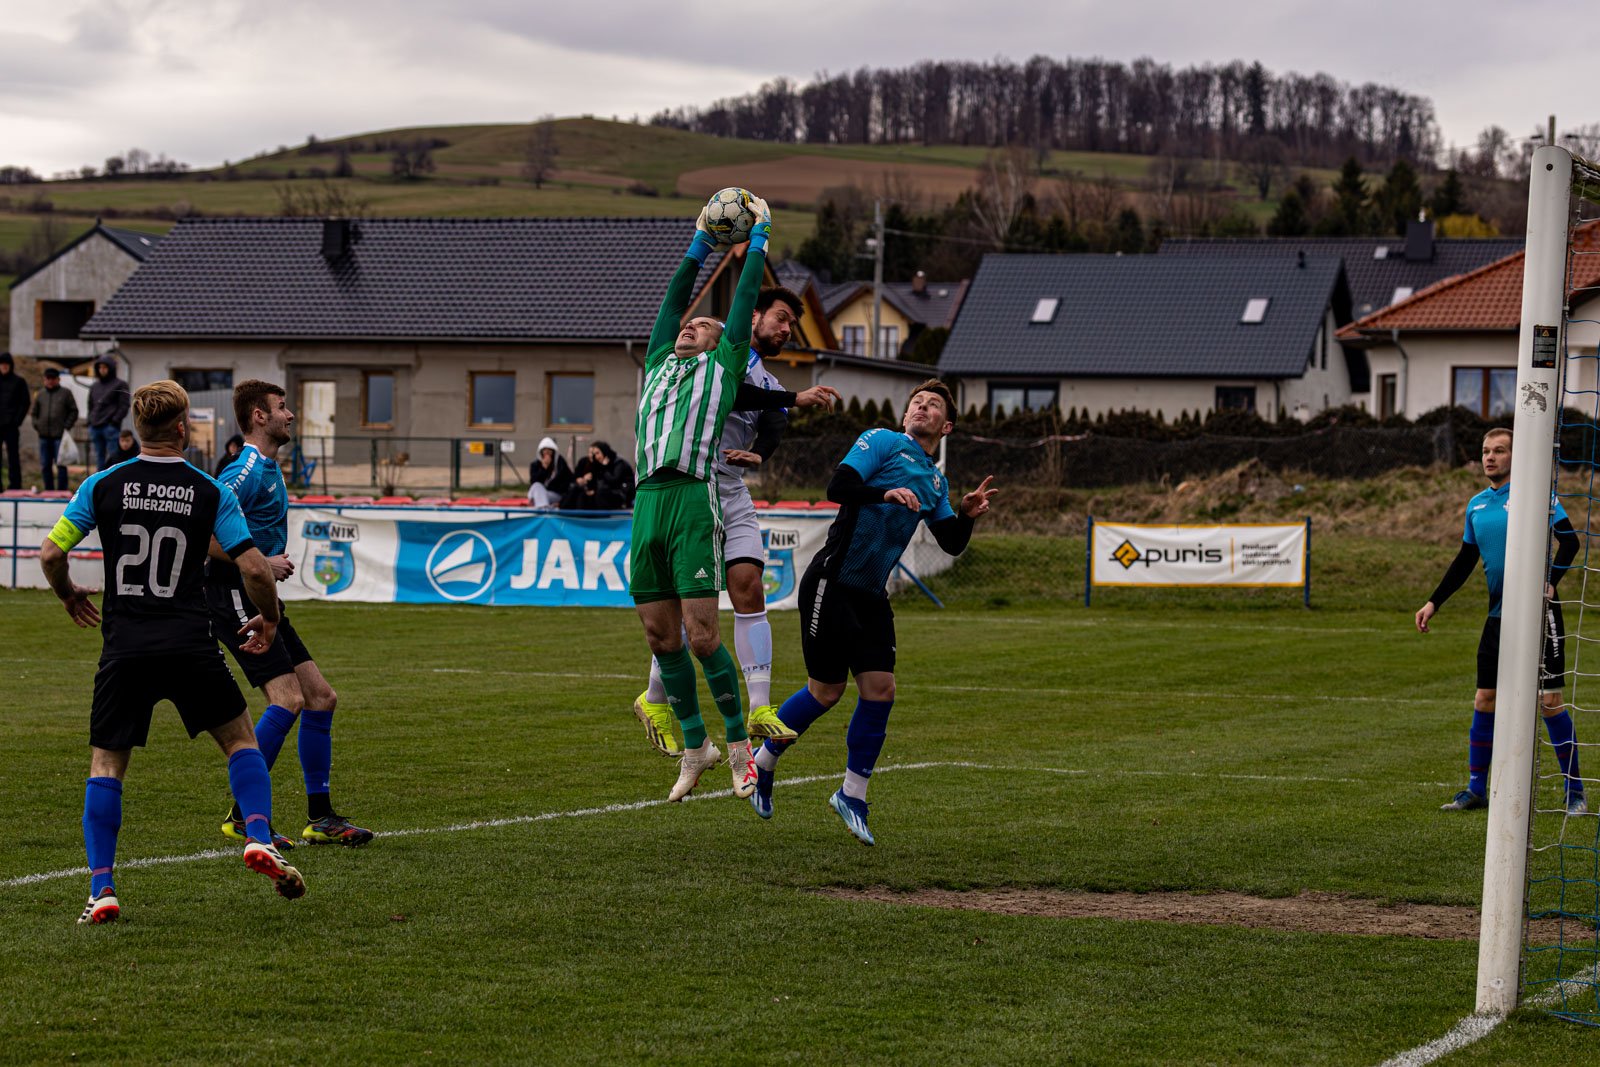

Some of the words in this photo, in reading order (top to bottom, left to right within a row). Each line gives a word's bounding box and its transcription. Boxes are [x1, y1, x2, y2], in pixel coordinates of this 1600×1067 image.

[123, 482, 141, 496] KS
[147, 483, 195, 502] POGOŃ
[122, 495, 193, 516] ŚWIERZAWA
[116, 523, 187, 598] 20
[510, 538, 632, 591] JAK
[1145, 543, 1223, 568] puris
